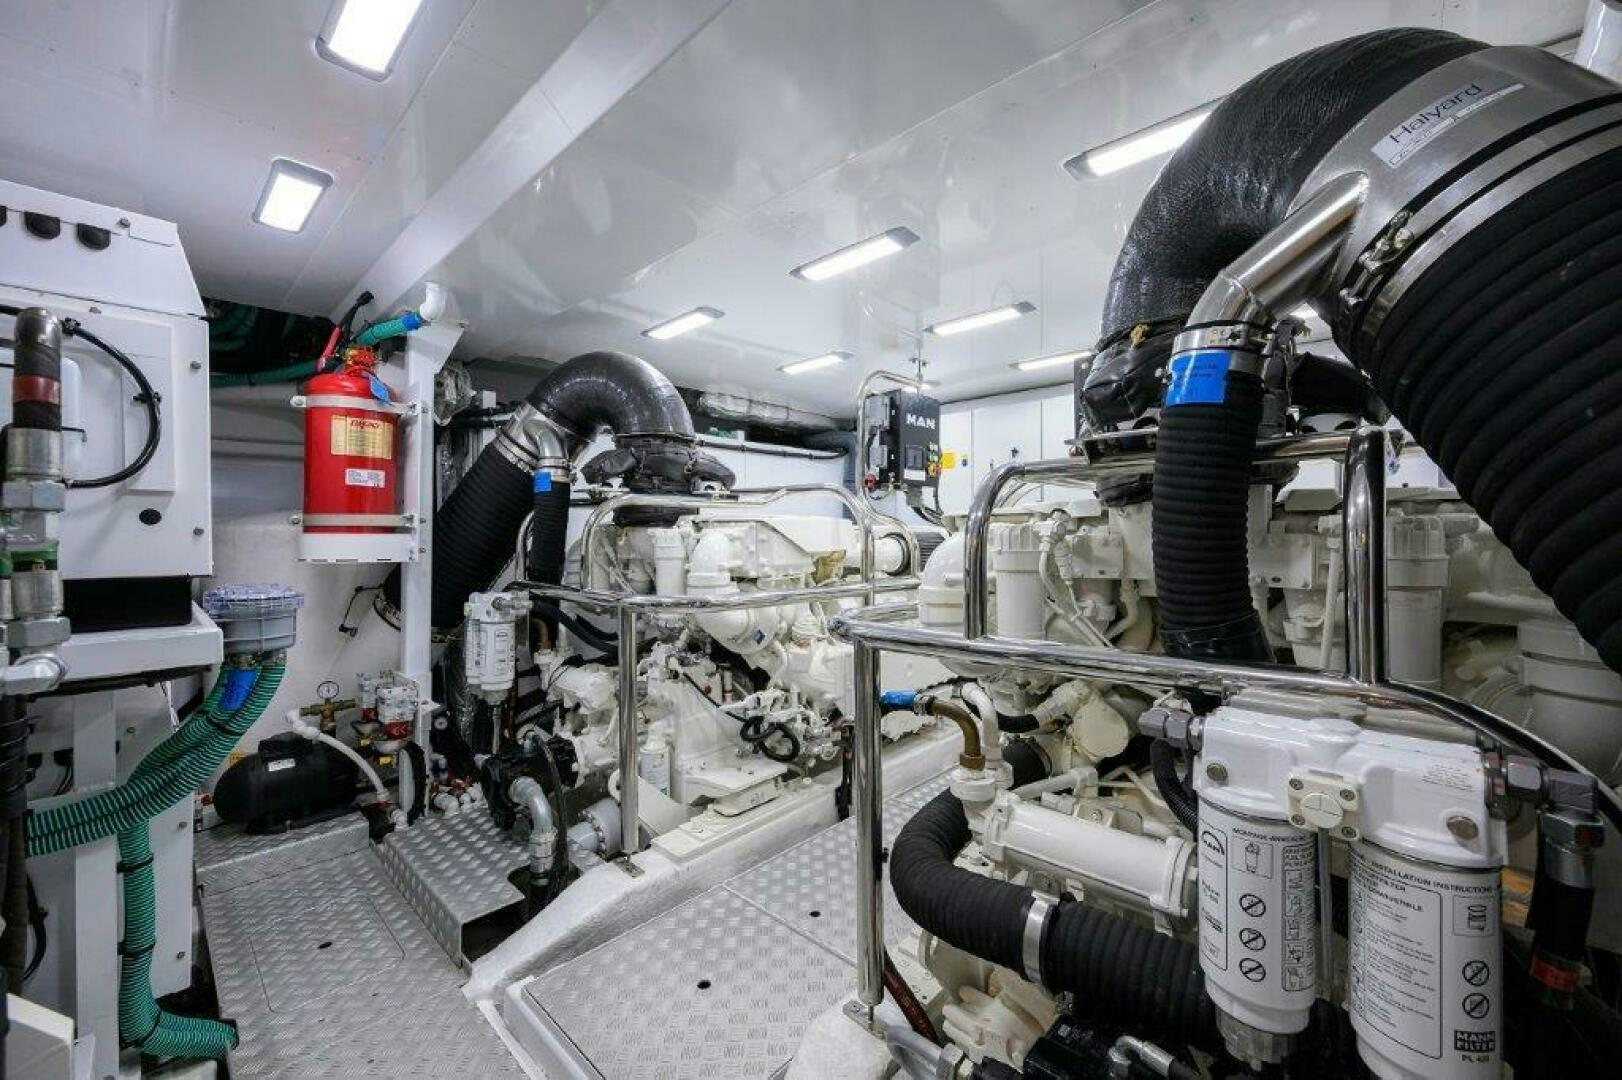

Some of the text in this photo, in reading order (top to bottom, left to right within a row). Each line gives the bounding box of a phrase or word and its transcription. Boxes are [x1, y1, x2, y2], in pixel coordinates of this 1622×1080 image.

[1389, 83, 1482, 143] Halyard
[906, 413, 936, 430] MAN
[1371, 861, 1431, 886] INSTALLATION
[1456, 1031, 1496, 1041] MANN
[1456, 1041, 1496, 1051] FILTER
